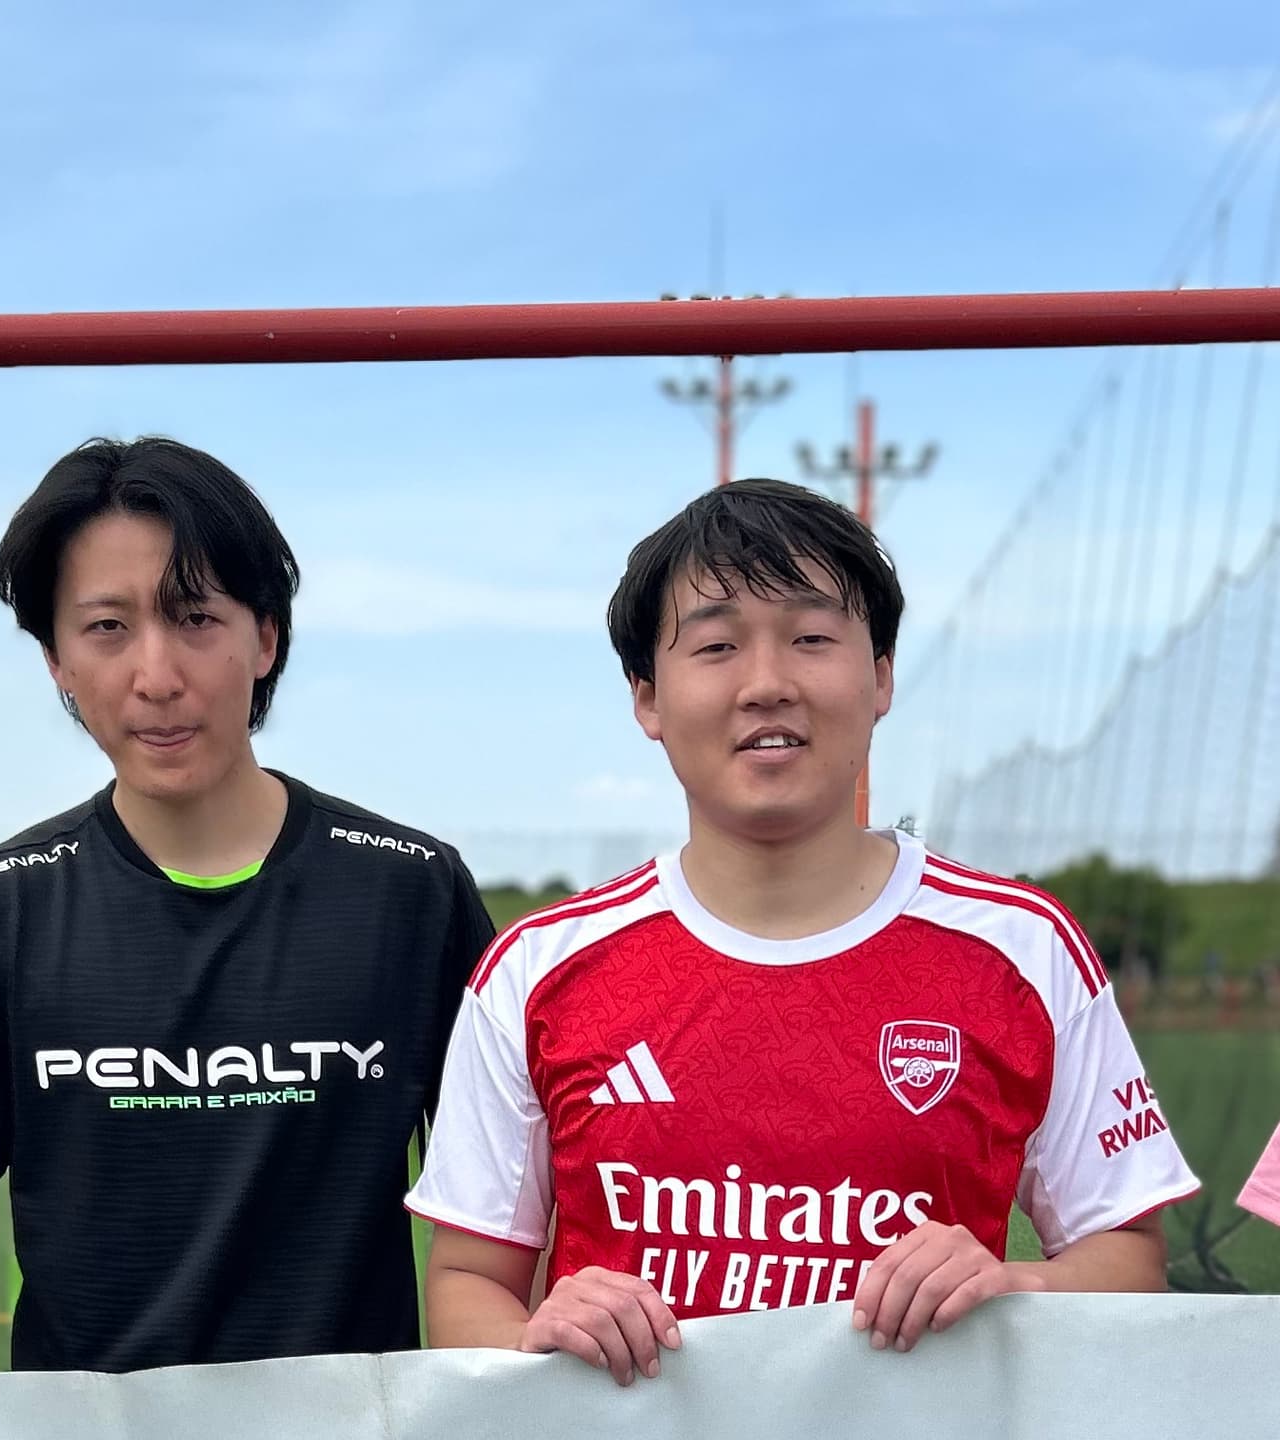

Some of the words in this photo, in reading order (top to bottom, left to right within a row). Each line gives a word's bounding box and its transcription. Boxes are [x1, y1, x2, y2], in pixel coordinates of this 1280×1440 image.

[330, 827, 436, 860] PENALTY
[891, 1034, 950, 1054] Arsenal
[35, 1041, 384, 1089] PENALTY
[207, 1095, 225, 1109] E
[595, 1161, 934, 1246] Emirates
